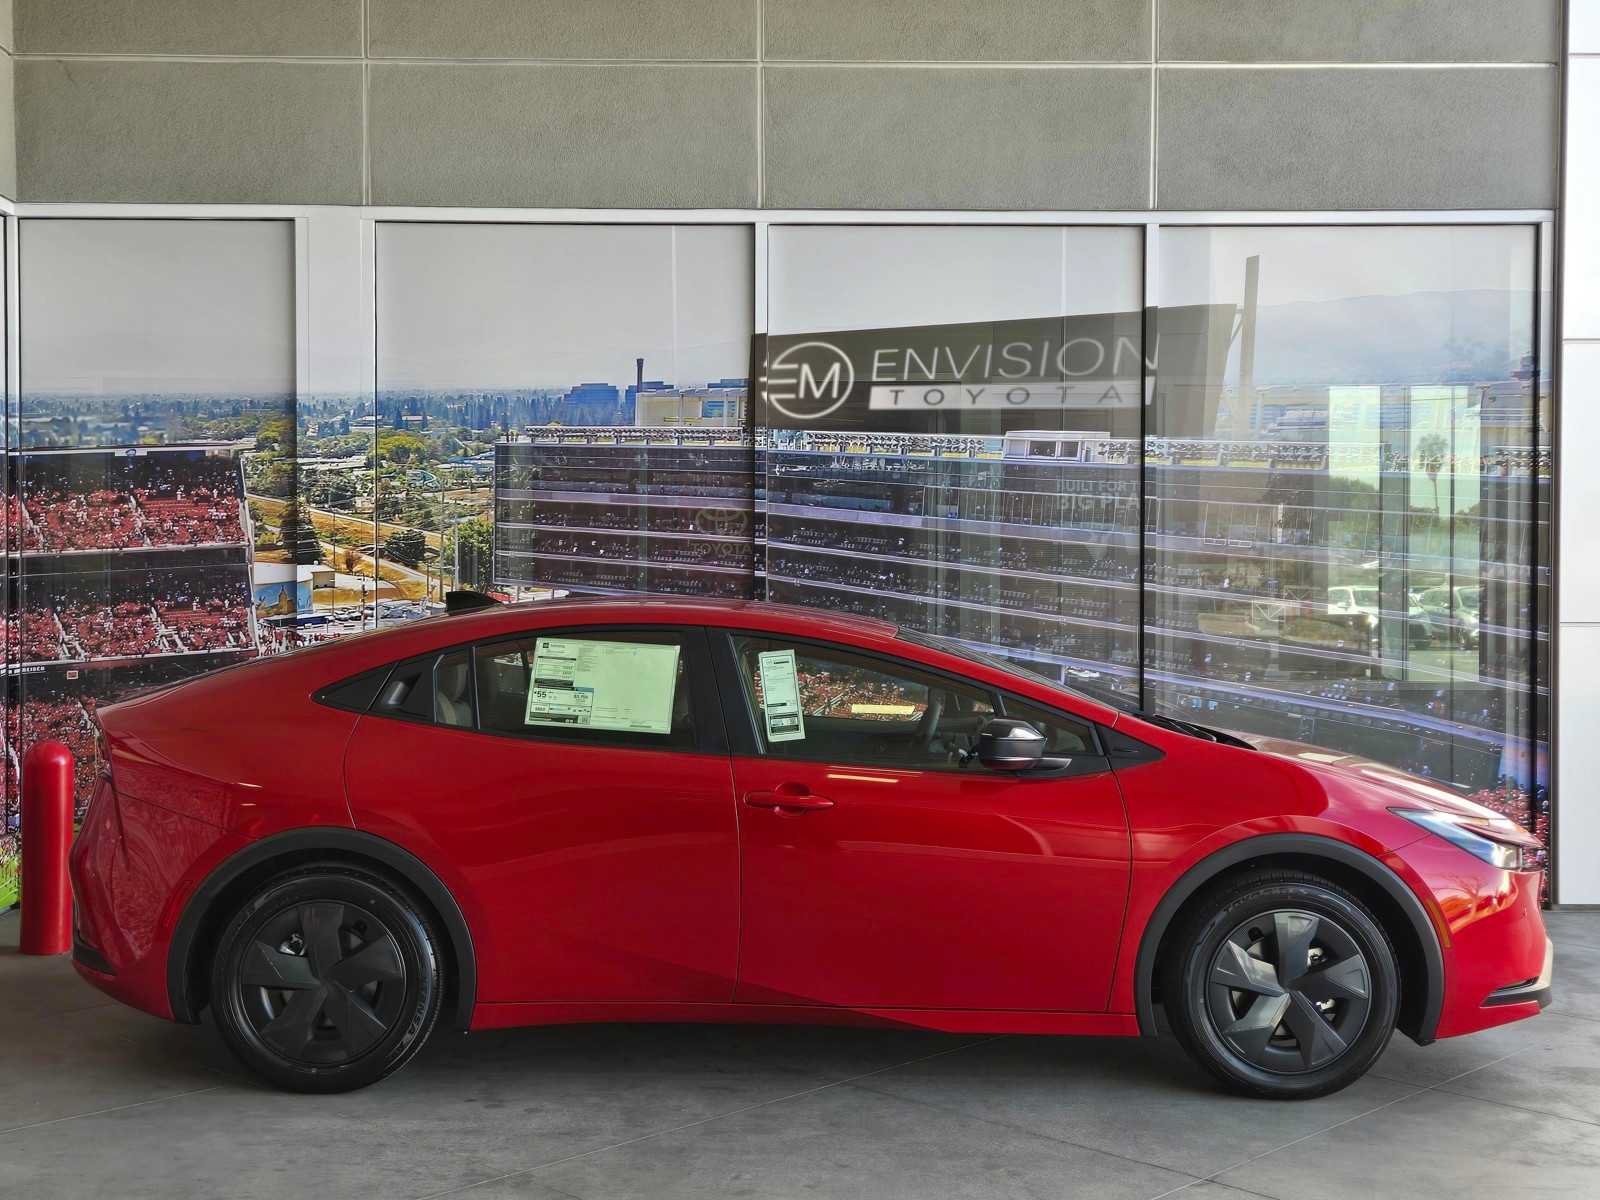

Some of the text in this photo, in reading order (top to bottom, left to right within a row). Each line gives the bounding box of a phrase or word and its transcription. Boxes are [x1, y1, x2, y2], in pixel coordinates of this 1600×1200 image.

[872, 333, 1160, 382] ENVISION
[888, 383, 1123, 407] TOYOTA
[690, 543, 753, 555] TOYOTA
